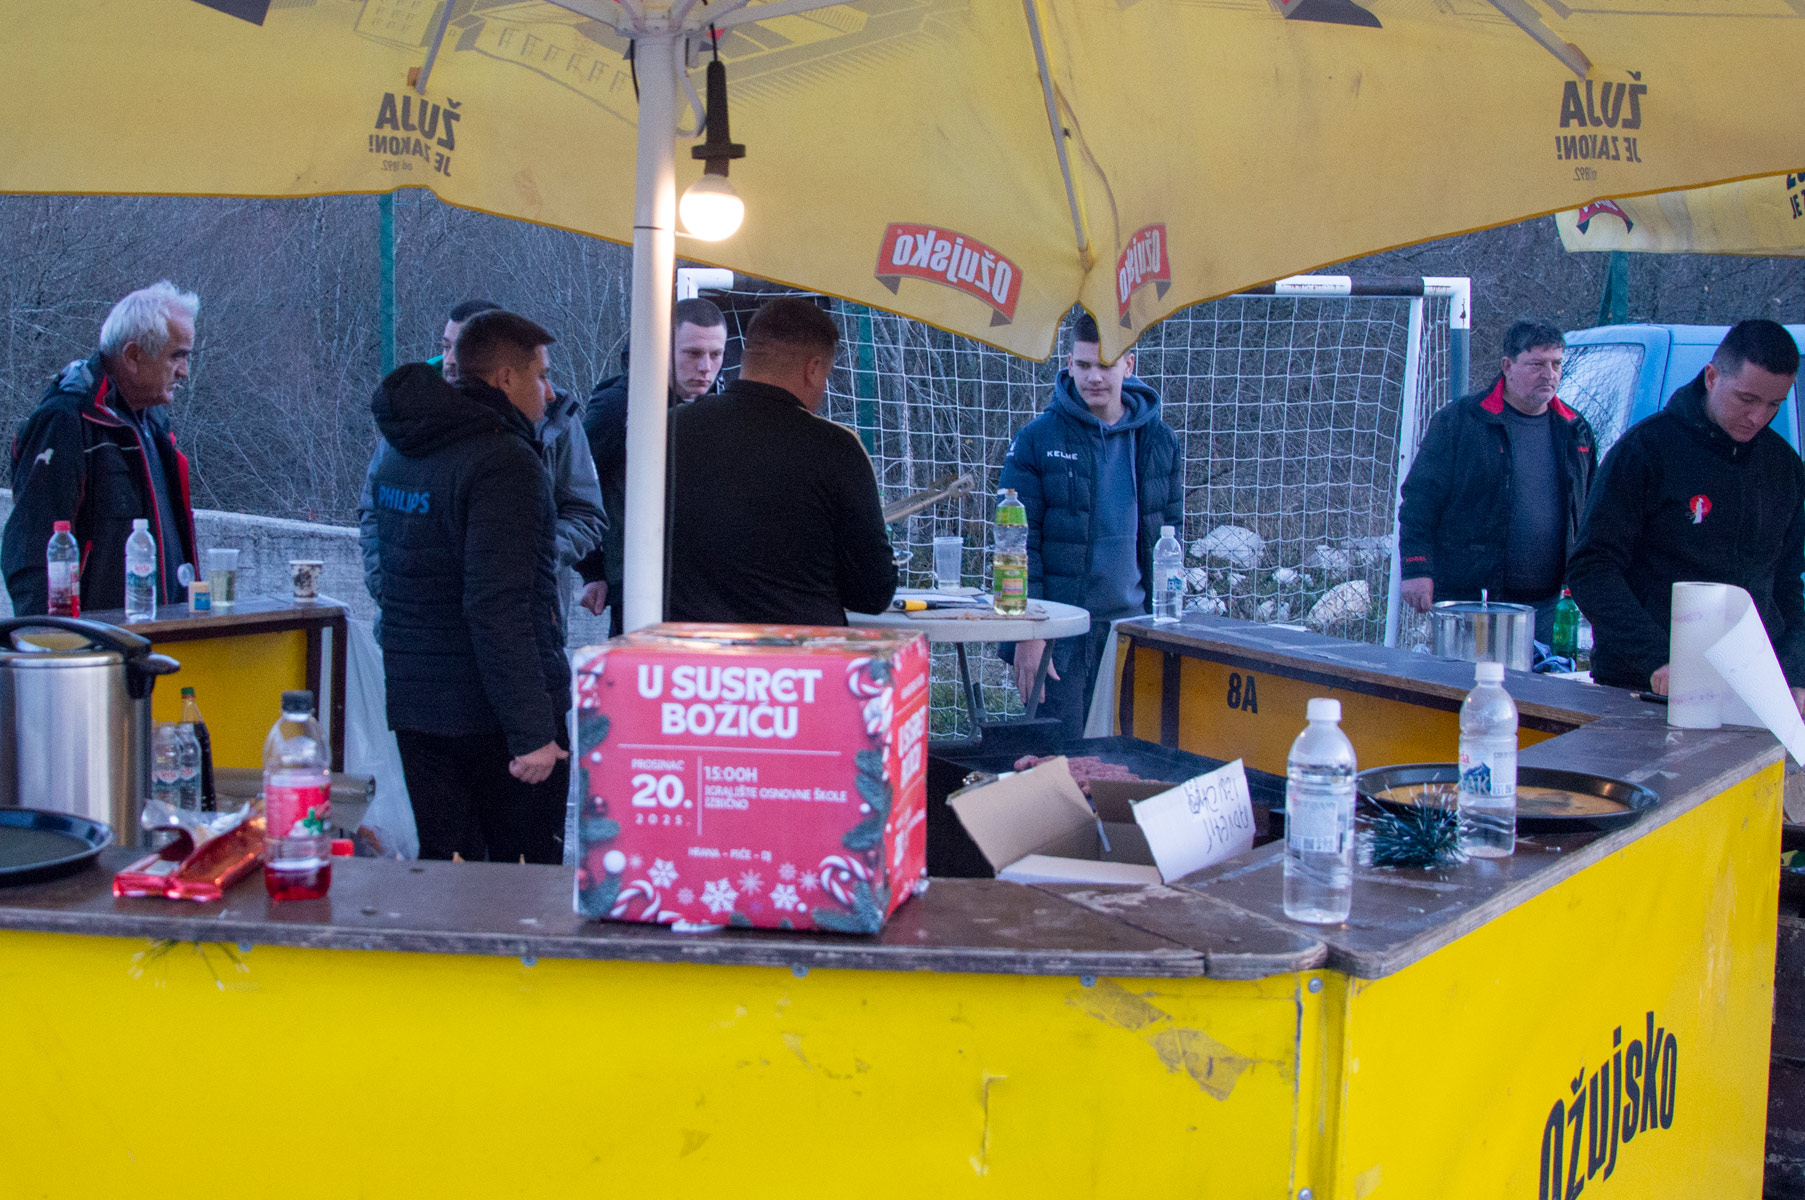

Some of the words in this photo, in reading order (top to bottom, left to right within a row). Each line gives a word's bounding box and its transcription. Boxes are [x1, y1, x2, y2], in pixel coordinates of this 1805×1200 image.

[1046, 450, 1078, 460] KELME
[379, 485, 430, 513] PHILIPS
[637, 664, 664, 699] U
[671, 665, 823, 703] SUSRET
[1227, 672, 1258, 714] 8A
[661, 700, 798, 739] BOŽIĆU
[631, 773, 693, 809] 20.
[704, 765, 758, 783] 15:00H
[1538, 1010, 1678, 1200] Ožujsko
